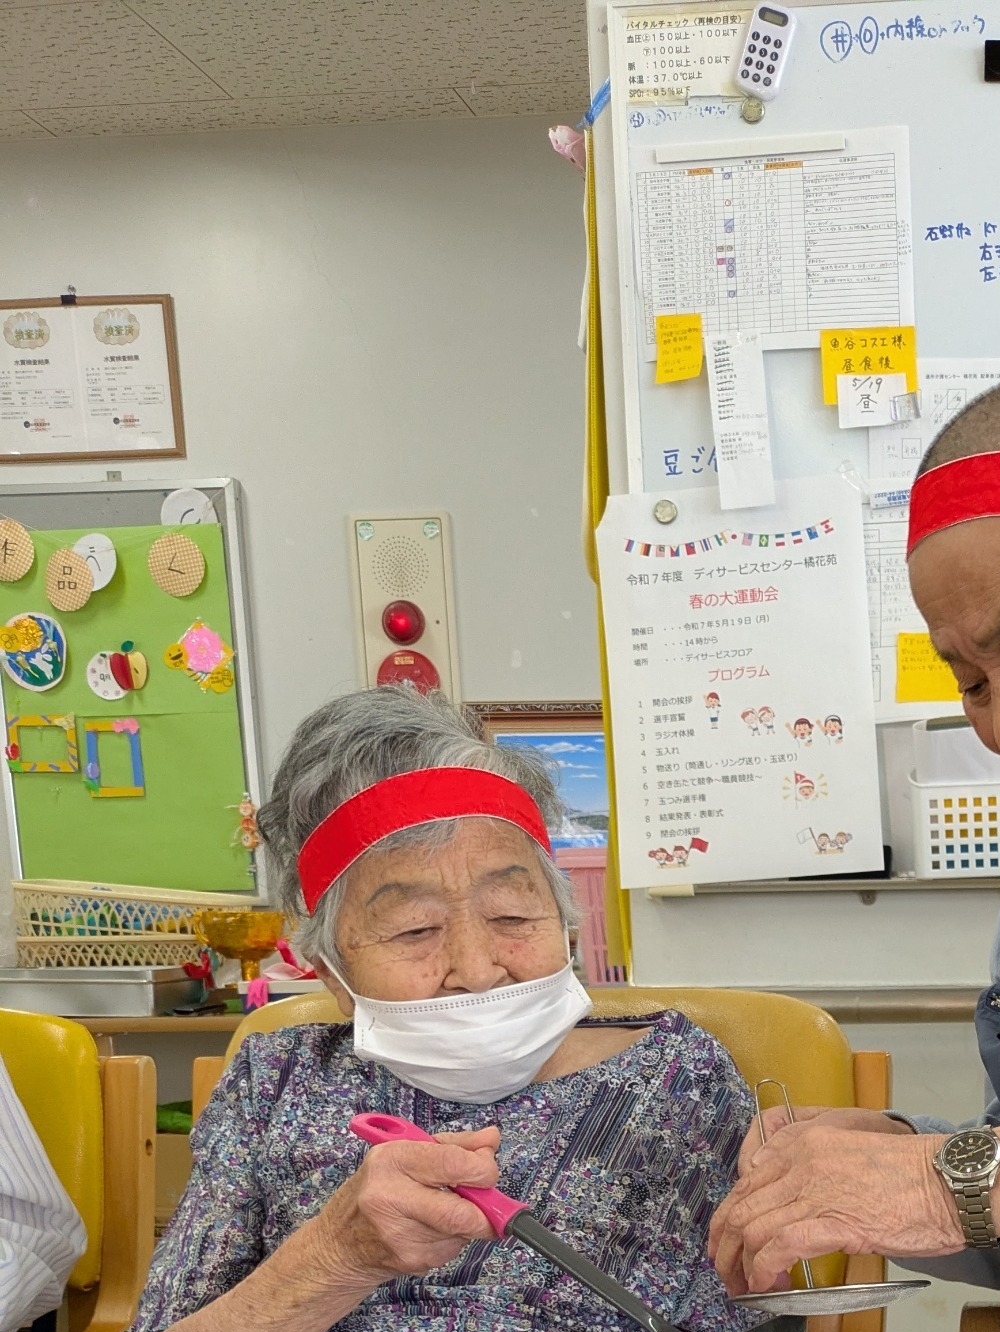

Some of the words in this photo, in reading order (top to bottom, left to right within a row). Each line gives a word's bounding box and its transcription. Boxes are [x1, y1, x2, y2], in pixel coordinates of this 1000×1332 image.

[842, 356, 894, 373] 昼食後
[852, 376, 883, 394] 5/19
[856, 394, 878, 413] 昼
[689, 586, 779, 609] 春の大運動会
[632, 627, 653, 636] 開催日
[633, 643, 648, 652] 時間
[634, 658, 648, 667] 場所
[709, 666, 770, 682] プログラム
[655, 729, 695, 740] ラジオ体操
[656, 747, 679, 757] 玉入れ
[658, 794, 706, 805] 玉つみ選手権
